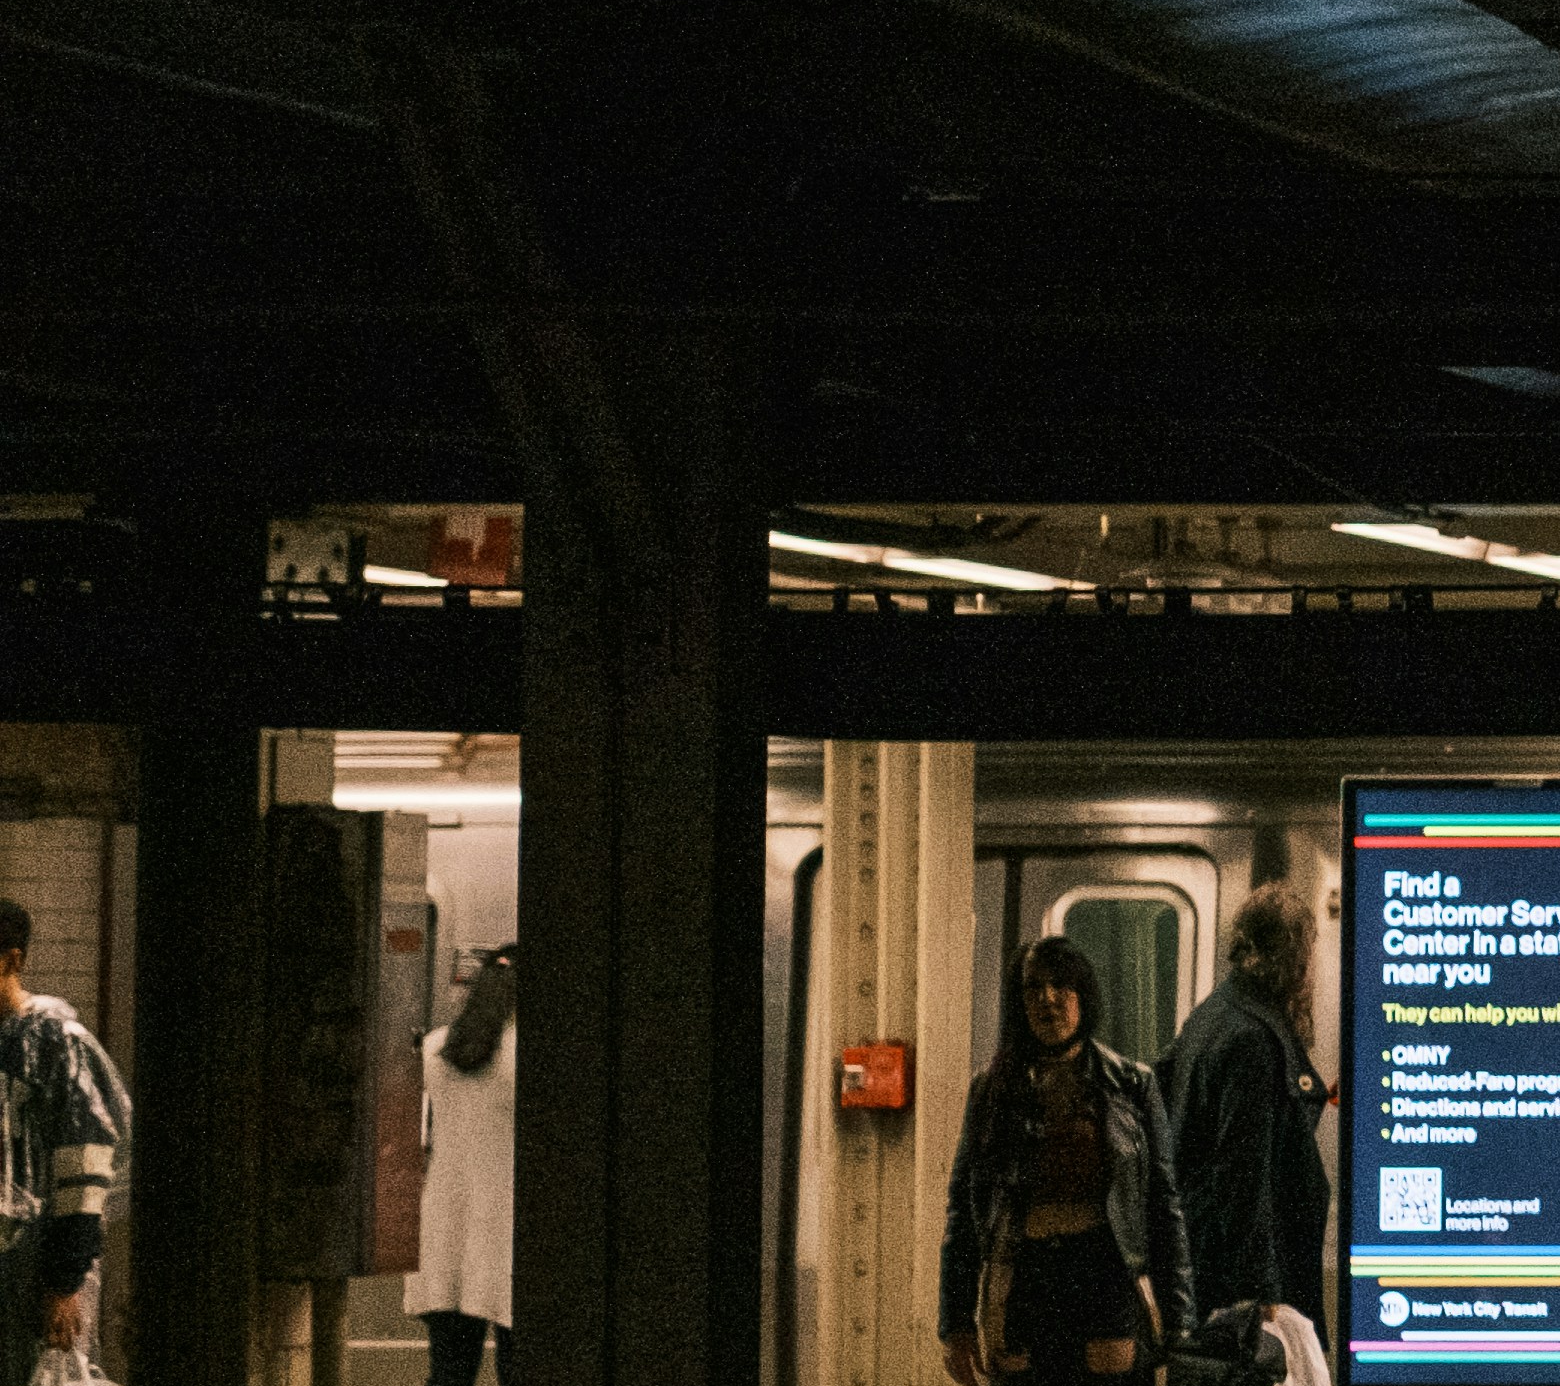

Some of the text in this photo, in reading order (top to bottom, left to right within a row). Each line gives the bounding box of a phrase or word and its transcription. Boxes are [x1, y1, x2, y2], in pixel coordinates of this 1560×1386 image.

[1384, 870, 1460, 898] Find a
[1383, 899, 1508, 926] Customer
[1383, 928, 1471, 956] Center
[1473, 928, 1498, 955] in
[1500, 934, 1516, 955] a
[1382, 962, 1491, 989] near you
[1382, 1002, 1428, 1026] They
[1429, 1007, 1463, 1023] can
[1465, 1002, 1505, 1026] help
[1506, 1007, 1539, 1026] you
[1391, 1044, 1451, 1066] OMNY
[1391, 1071, 1516, 1091] Reduced-Fare
[1391, 1097, 1481, 1117] Directions
[1482, 1097, 1516, 1117] and
[1391, 1123, 1478, 1143] And more
[1446, 1197, 1541, 1214] Locations and
[1446, 1215, 1509, 1232] more info
[1412, 1301, 1548, 1320] New York City Transit
